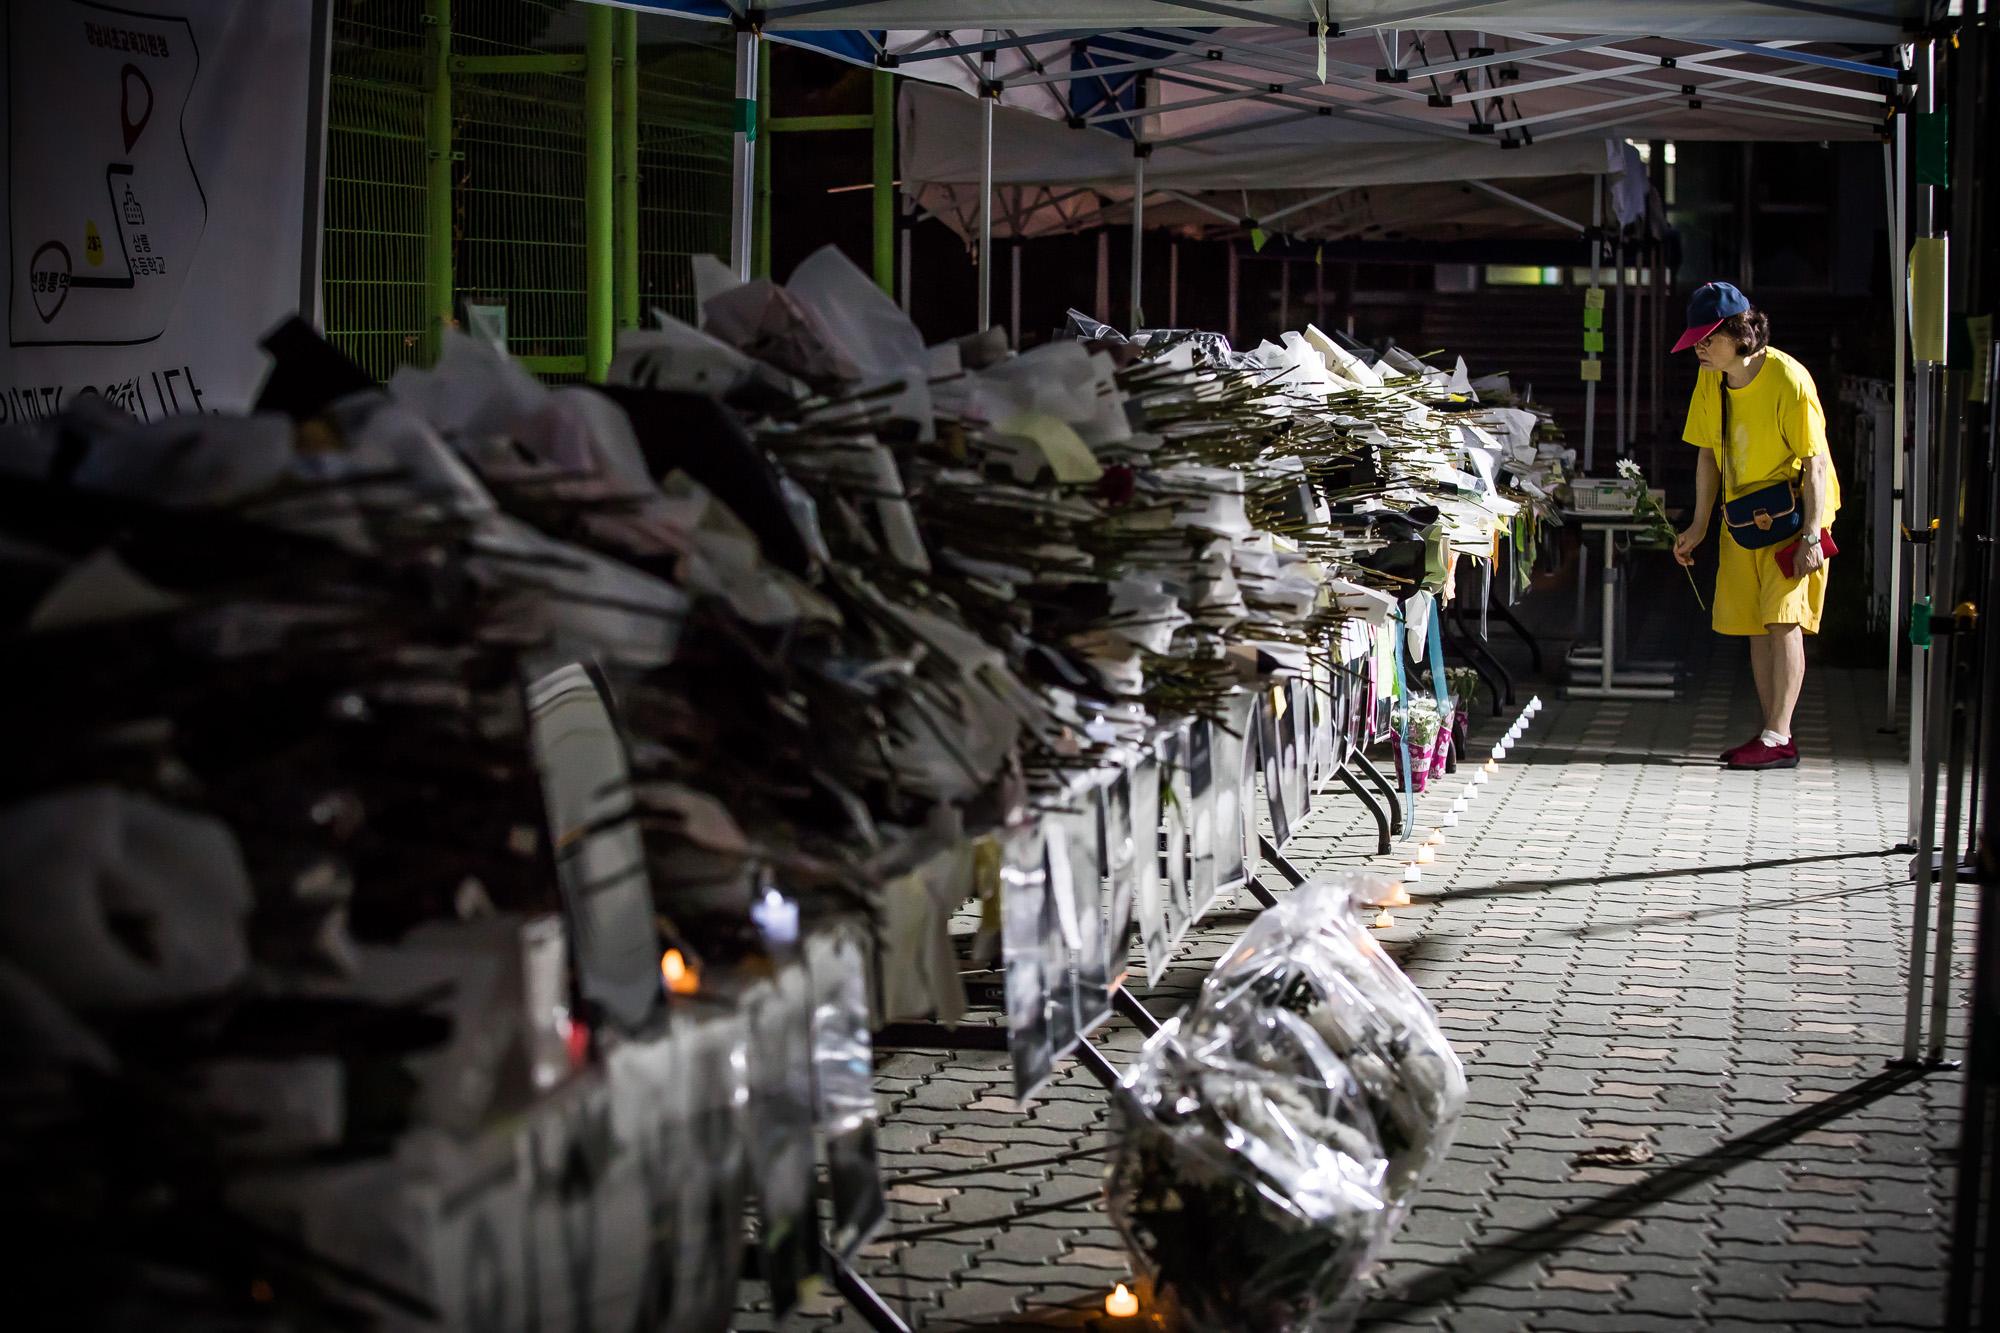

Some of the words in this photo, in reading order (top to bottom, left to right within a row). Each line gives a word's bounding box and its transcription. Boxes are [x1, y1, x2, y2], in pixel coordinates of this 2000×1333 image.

[84, 22, 169, 58] 강남서초교육지원청
[132, 234, 151, 253] 삼릉
[130, 257, 166, 275] 초등학교
[31, 271, 70, 293] 선정릉역
